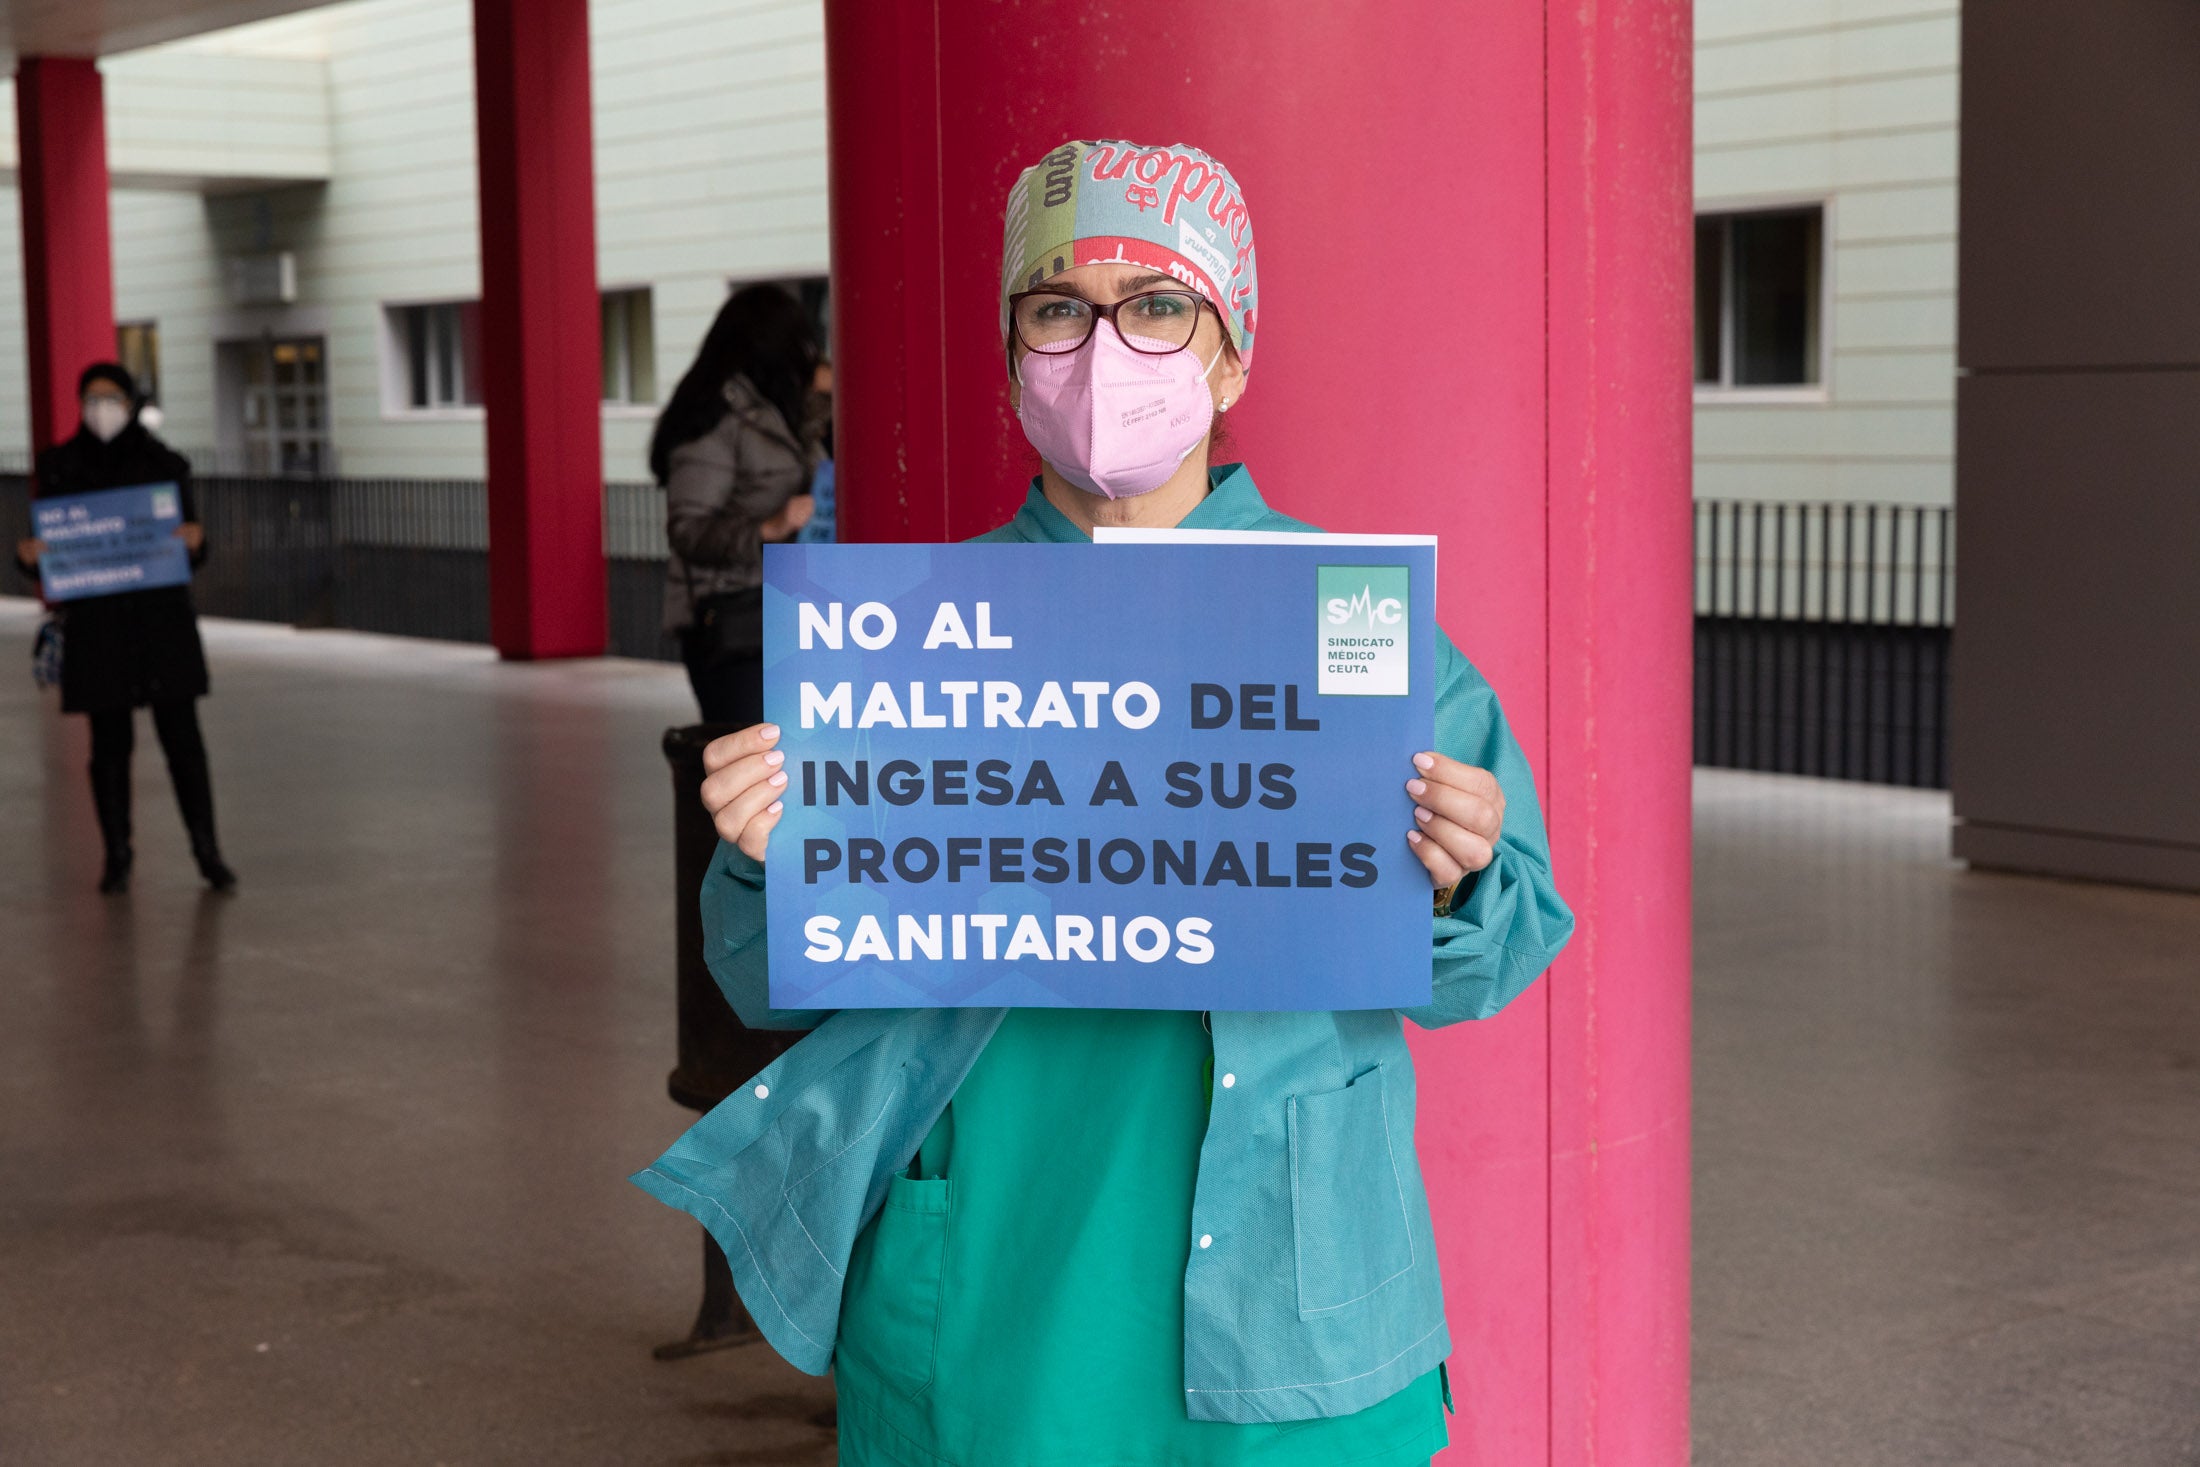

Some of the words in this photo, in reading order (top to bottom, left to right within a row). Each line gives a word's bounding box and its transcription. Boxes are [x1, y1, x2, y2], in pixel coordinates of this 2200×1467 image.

[799, 602, 897, 650] NO
[923, 602, 1012, 650] AL
[1327, 583, 1402, 631] SMC
[1328, 637, 1394, 647] SINDICATO
[1328, 649, 1376, 660] MÉDICO
[1328, 664, 1368, 674] CEUTA
[800, 681, 1160, 729] MALTRATO
[1191, 683, 1320, 732] DEL
[803, 760, 1064, 807] INGESA
[1090, 761, 1138, 807] A
[1165, 762, 1297, 811] SUS
[804, 838, 1379, 889] PROFESIONALES
[804, 914, 1215, 964] SANITARIOS
